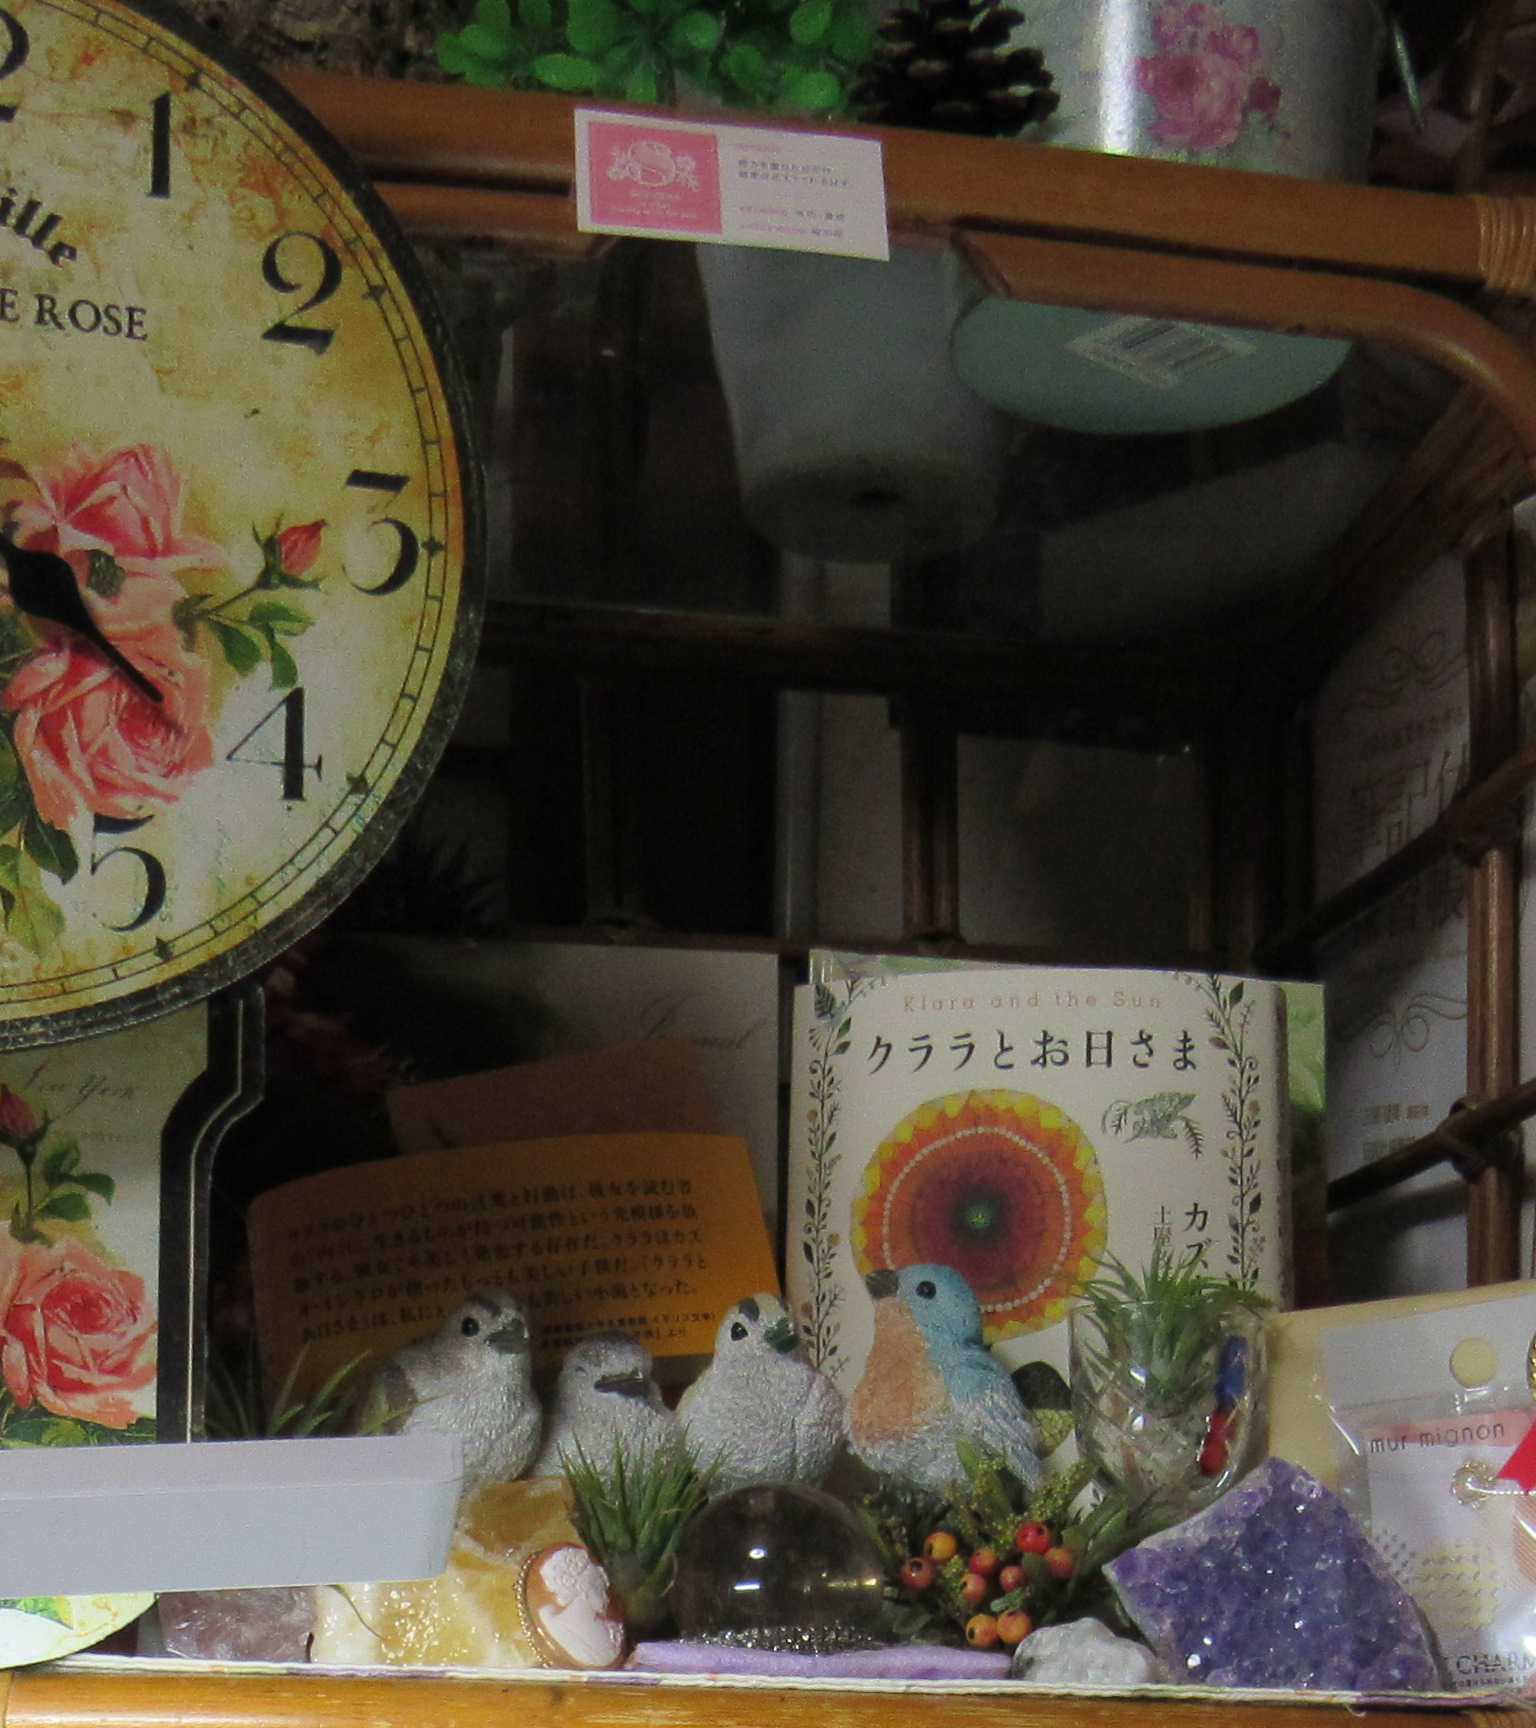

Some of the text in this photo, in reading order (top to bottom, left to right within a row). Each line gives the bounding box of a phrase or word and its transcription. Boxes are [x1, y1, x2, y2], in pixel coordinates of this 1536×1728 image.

[144, 89, 176, 199] 1
[34, 292, 148, 341] ROSE
[260, 230, 345, 355] 2
[342, 469, 420, 597] 3
[225, 687, 324, 802] 4
[82, 813, 167, 932] 5
[866, 1027, 1197, 1076] クララとお日さま
[904, 991, 1163, 1013] Klara and the Sun
[1370, 1421, 1506, 1454] mur mignon
